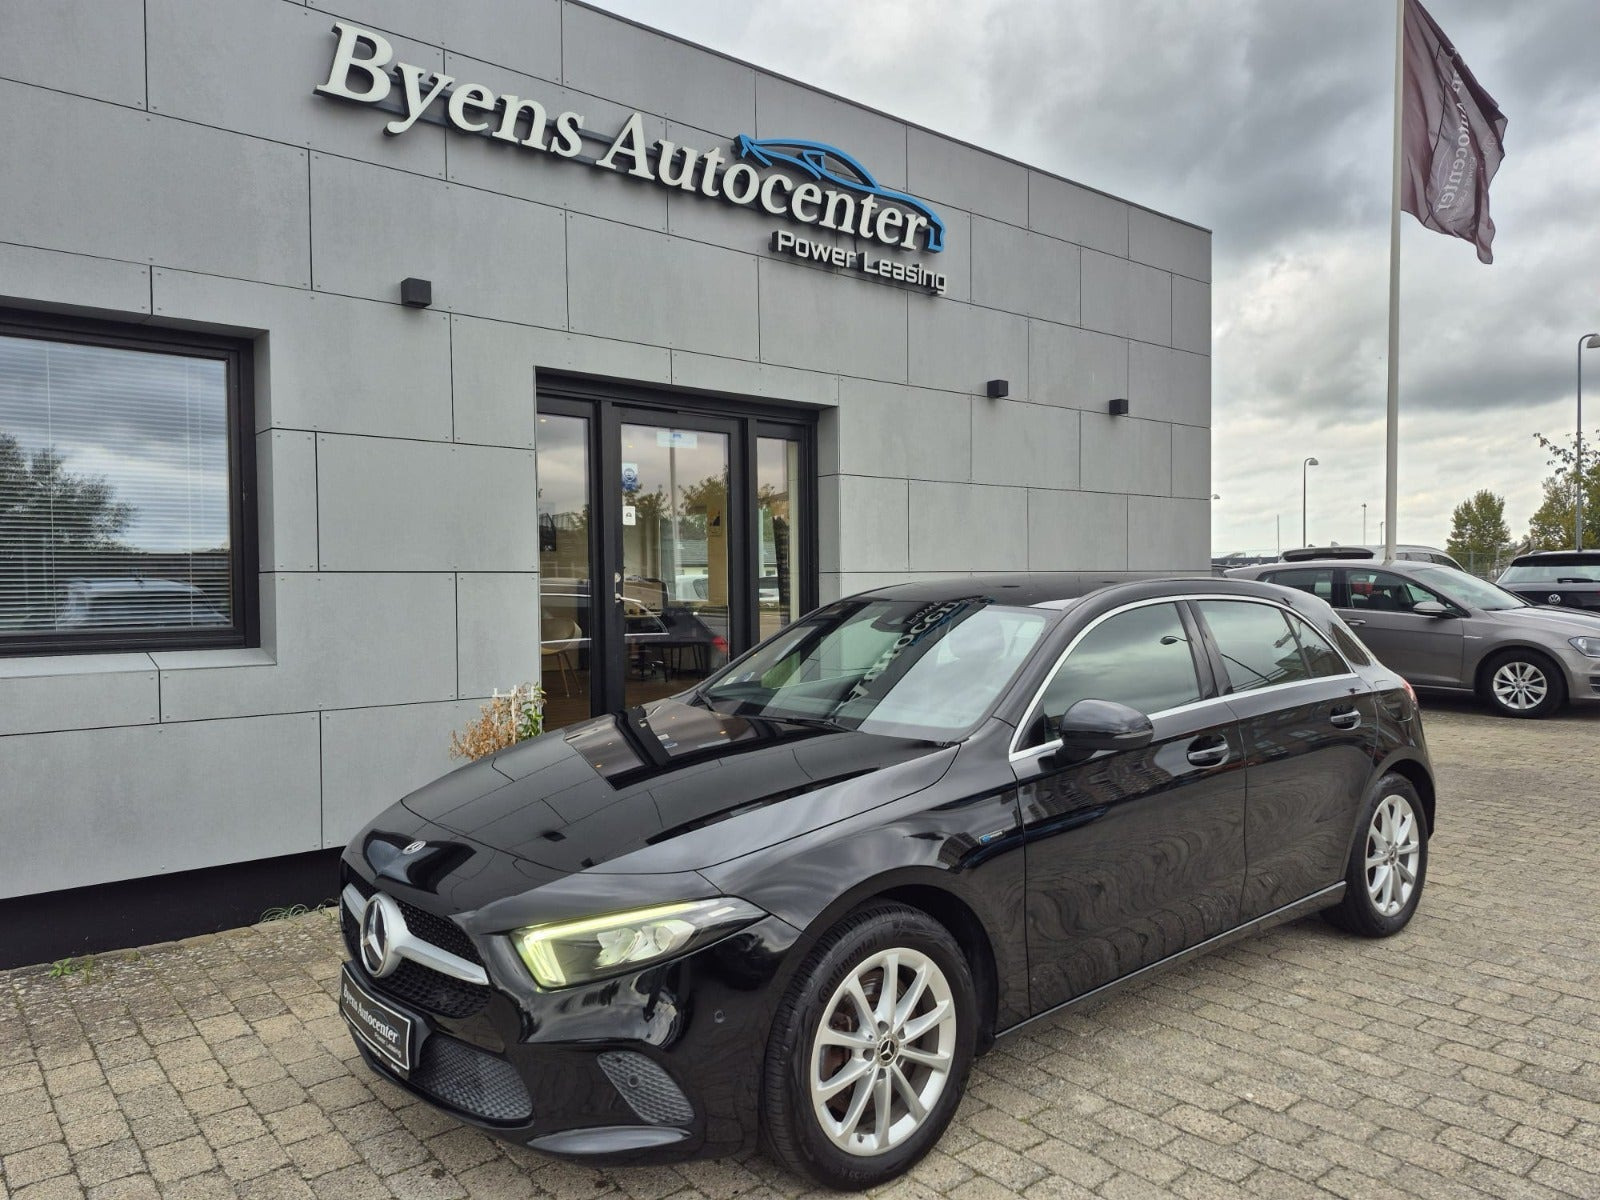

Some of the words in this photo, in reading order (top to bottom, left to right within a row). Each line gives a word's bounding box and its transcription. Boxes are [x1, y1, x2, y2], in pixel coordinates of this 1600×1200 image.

[313, 22, 585, 157] Byens
[596, 112, 927, 250] Autocenter
[776, 230, 857, 268] Power
[863, 252, 947, 295] Leasing
[358, 1002, 398, 1043] Autocenter
